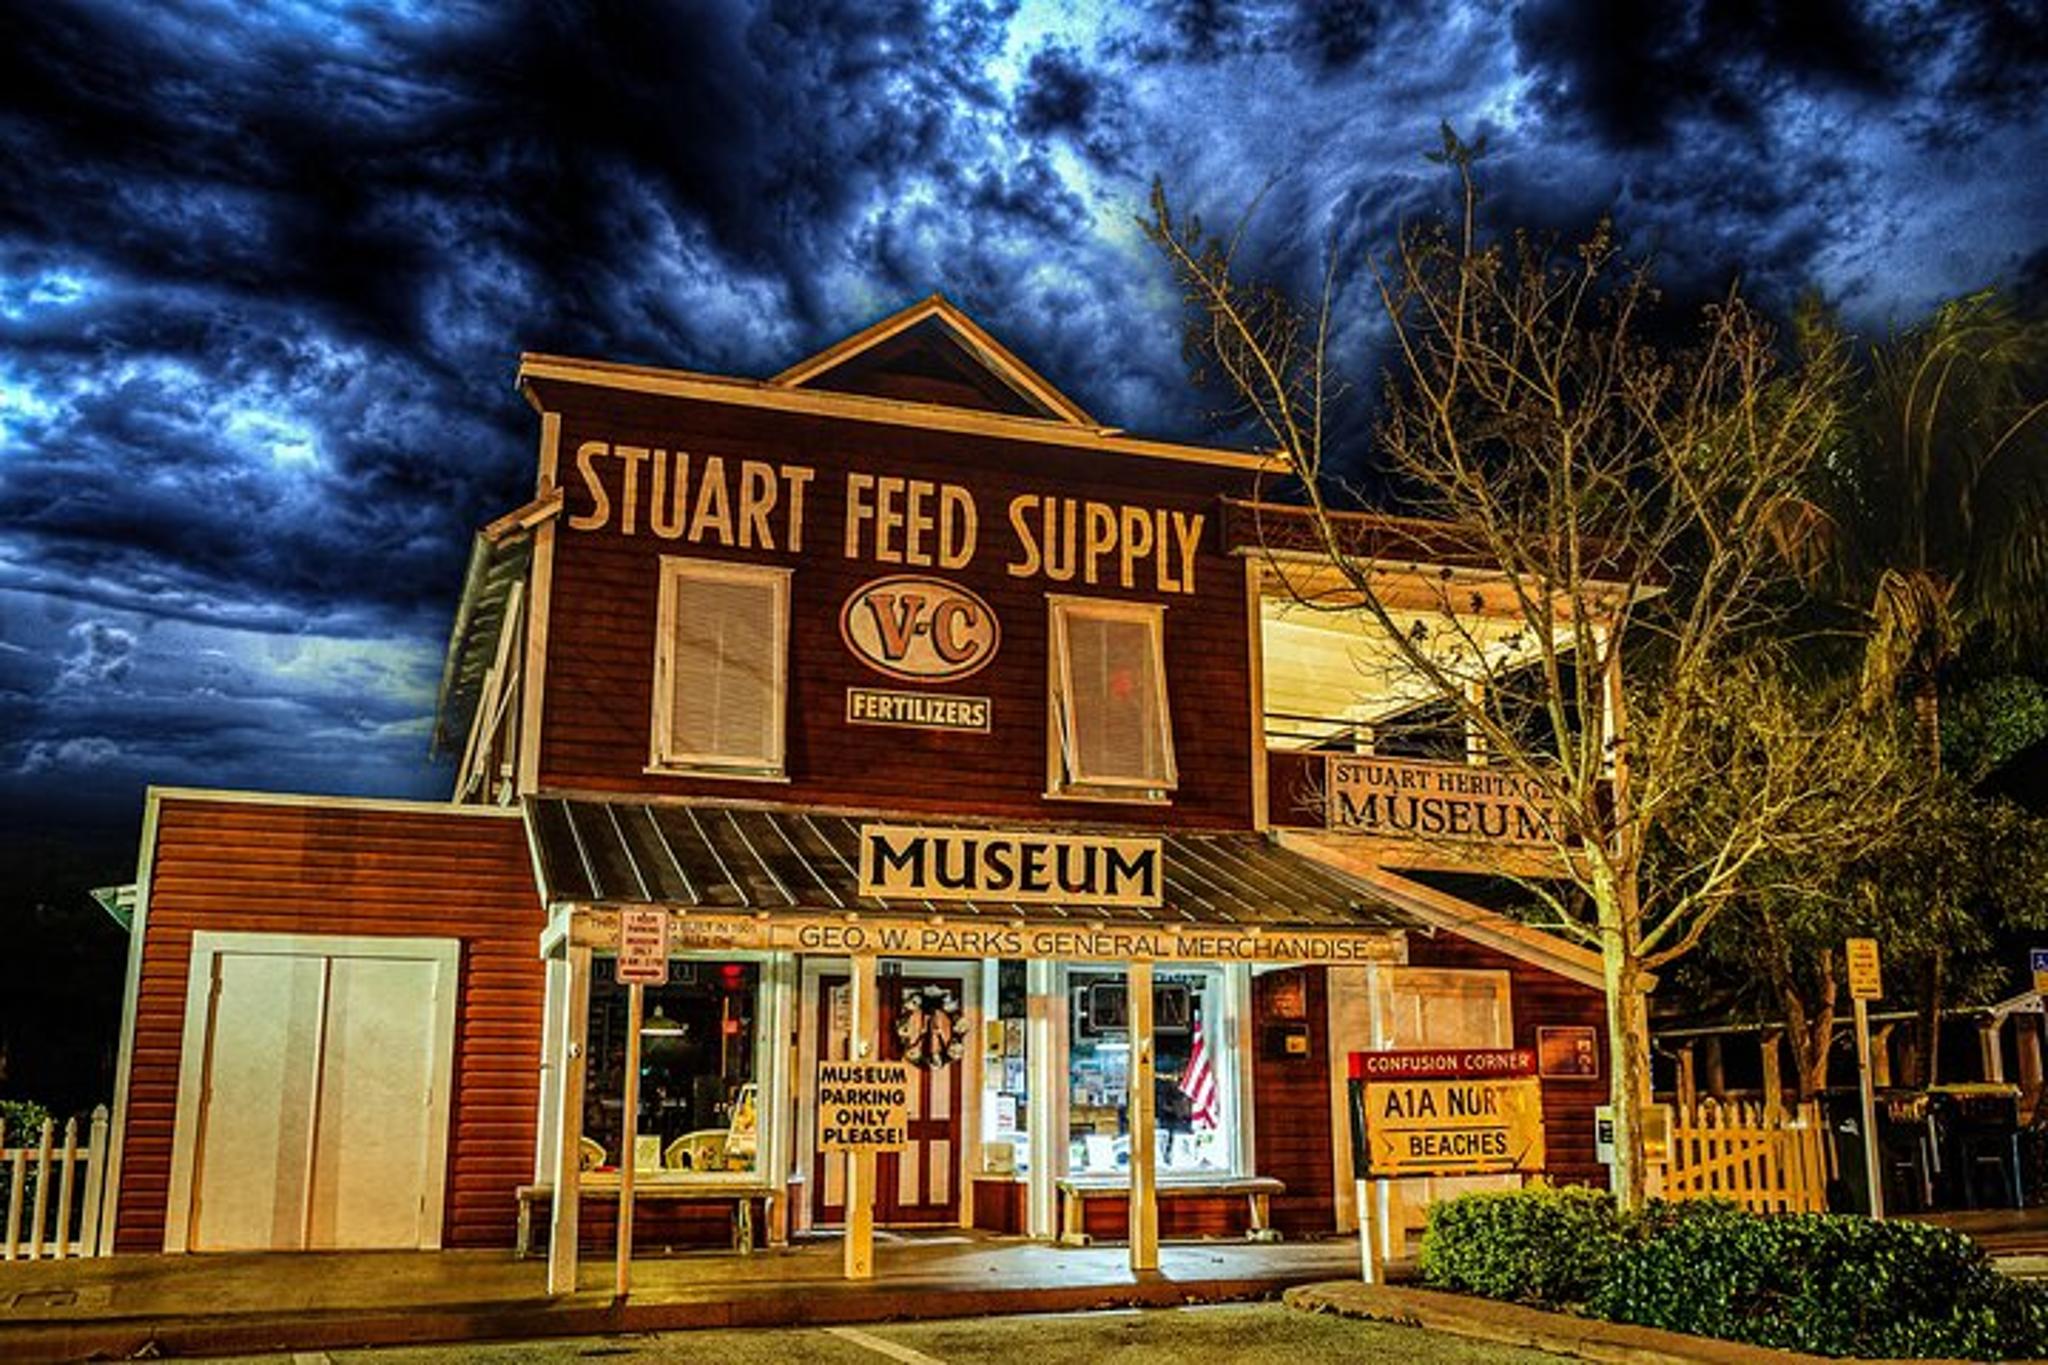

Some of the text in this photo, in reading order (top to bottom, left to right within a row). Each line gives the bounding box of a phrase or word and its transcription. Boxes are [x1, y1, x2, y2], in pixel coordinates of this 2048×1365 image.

[568, 441, 1205, 594] STUART FEED SUPPLY
[864, 593, 980, 664] V-C
[852, 695, 985, 727] FERTILIZERS
[1336, 763, 1430, 790] STUART
[1337, 790, 1553, 841] MUSEUM
[869, 834, 1156, 897] MUSEUM
[799, 925, 1368, 961] GEO. W. PARKS GENERAL MERCHANDISE
[821, 1066, 907, 1084] MUSEUM
[1367, 1052, 1530, 1074] CONFUSION CORNER
[821, 1088, 905, 1106] PARKING
[1384, 1088, 1437, 1119] A1A
[836, 1109, 890, 1126] ONLY
[823, 1128, 904, 1145] PLEASE!
[1409, 1132, 1507, 1156] BEACHES
